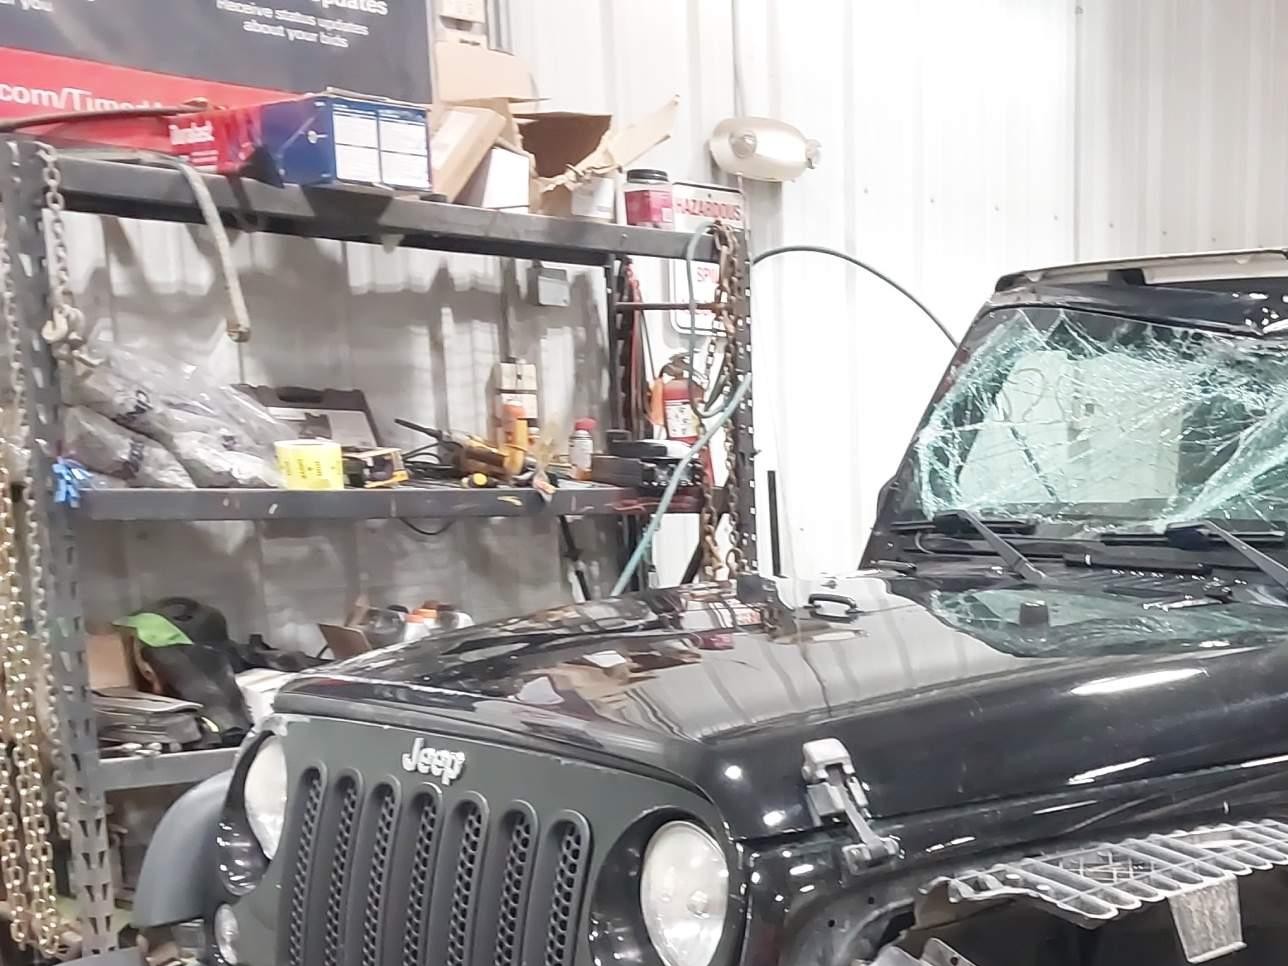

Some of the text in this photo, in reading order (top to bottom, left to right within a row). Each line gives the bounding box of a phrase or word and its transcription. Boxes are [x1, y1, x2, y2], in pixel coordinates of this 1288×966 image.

[242, 19, 349, 48] about your bids
[274, 10, 317, 26] status
[317, 18, 369, 36] updates
[402, 737, 466, 787] Jeep
